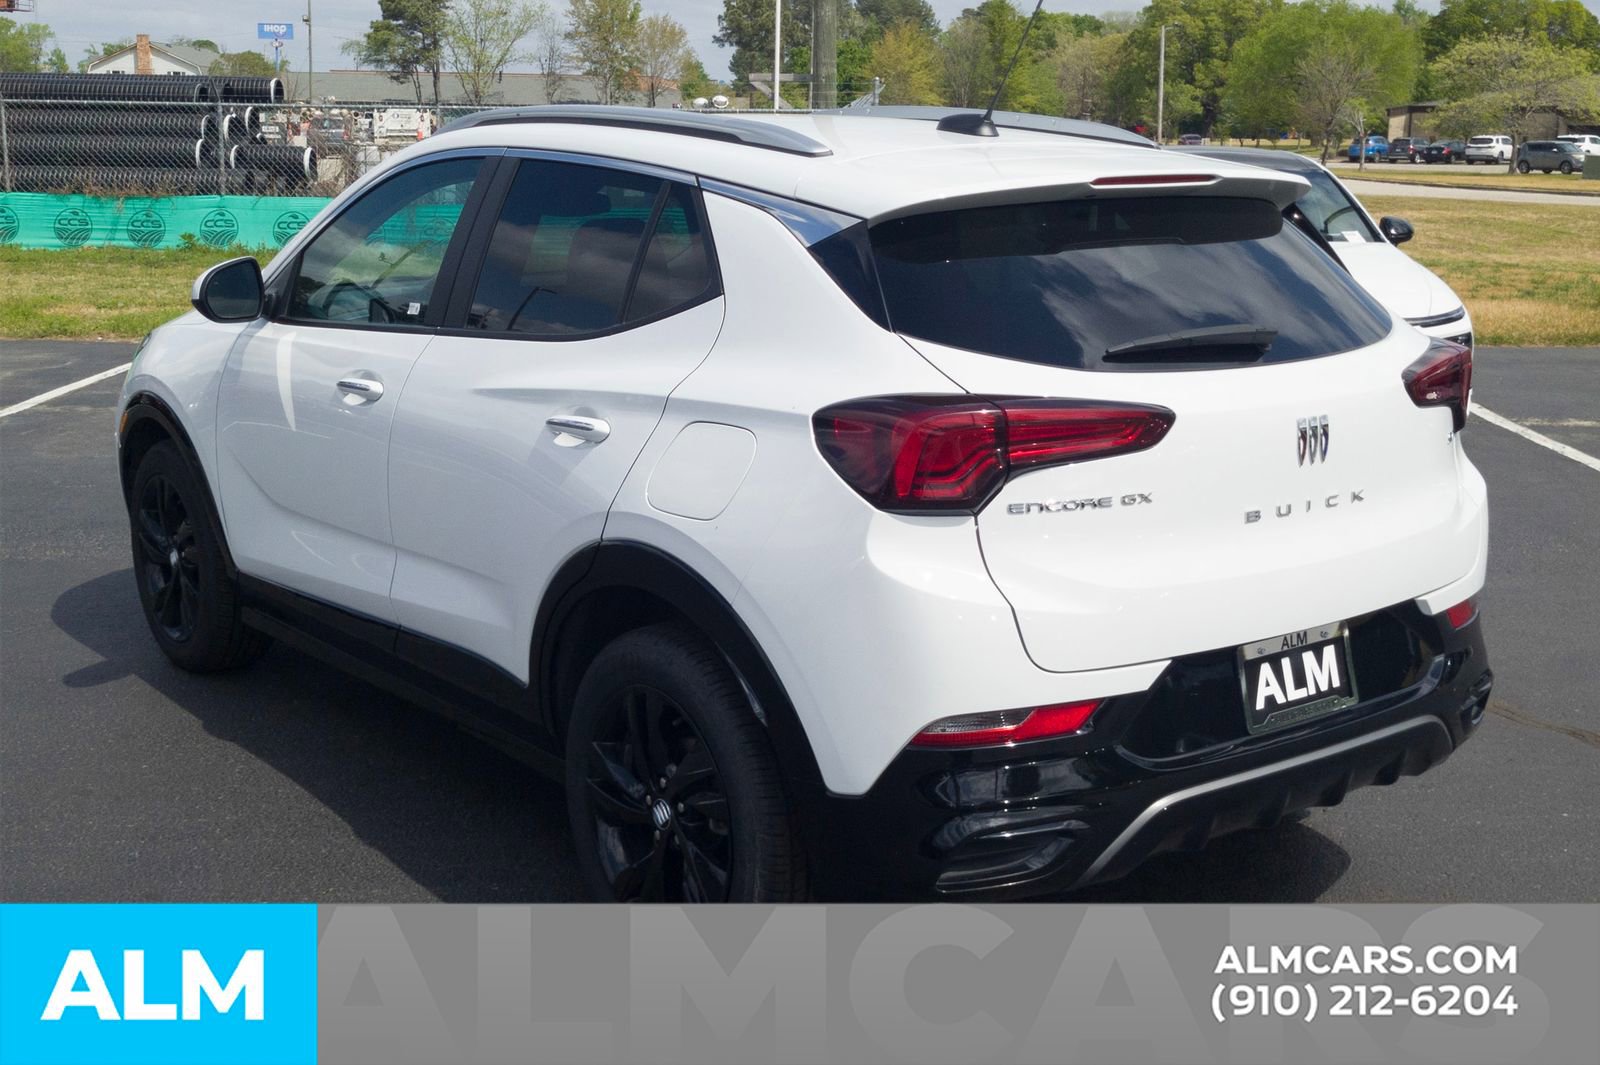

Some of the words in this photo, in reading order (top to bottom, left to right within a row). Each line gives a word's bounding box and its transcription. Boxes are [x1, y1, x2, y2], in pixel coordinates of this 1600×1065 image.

[58, 217, 90, 227] CCS
[130, 218, 162, 229] CCS
[204, 218, 235, 228] CCS
[1006, 496, 1113, 515] ENCORE
[1120, 492, 1153, 506] GX
[1244, 489, 1366, 525] BUICK
[1281, 631, 1308, 650] ALM
[1256, 644, 1341, 711] ALM
